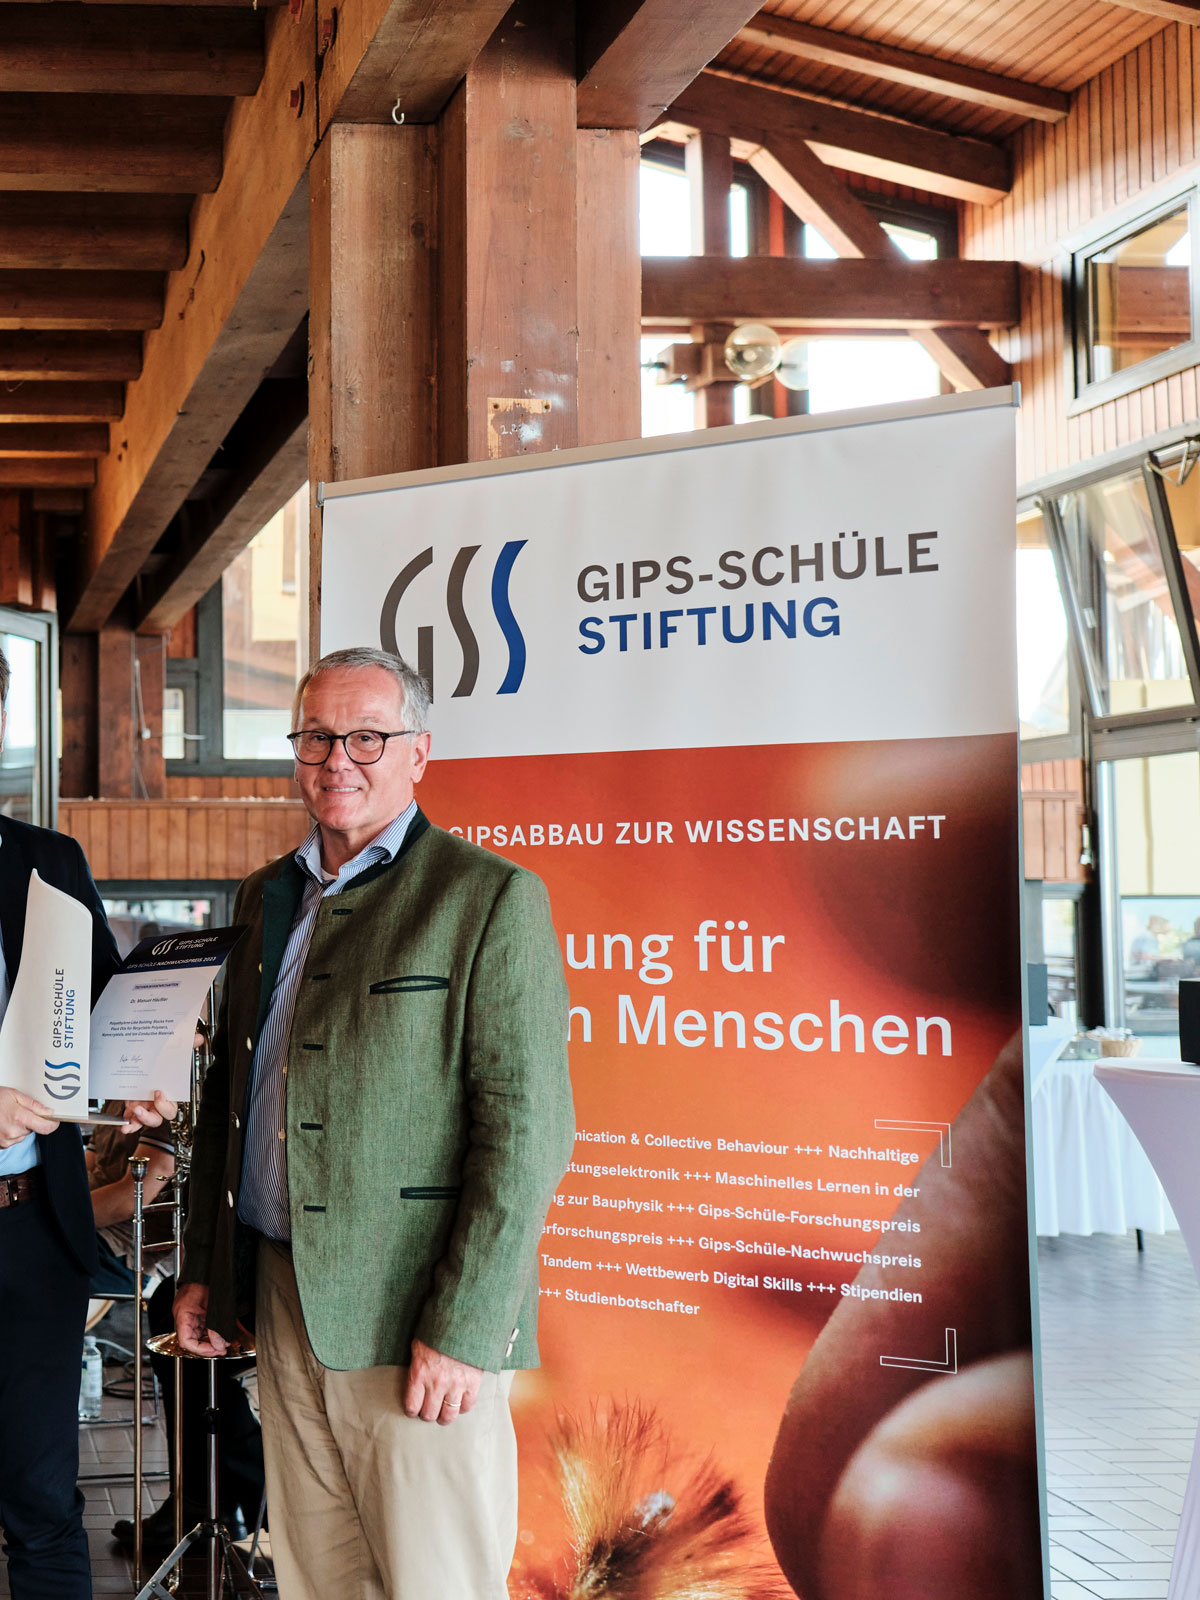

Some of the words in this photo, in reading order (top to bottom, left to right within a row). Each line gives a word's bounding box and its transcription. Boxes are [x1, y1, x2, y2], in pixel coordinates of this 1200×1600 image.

[577, 530, 940, 603] GIPS-SCHÜLE
[578, 596, 841, 655] STIFTUNG
[615, 821, 674, 845] ZUR
[685, 815, 946, 843] WISSENSCHAFT
[566, 933, 674, 985] ung
[693, 919, 786, 973] für
[52, 968, 65, 1048] GIPS-SCHÜLE
[64, 989, 76, 1049] STIFTUNG
[618, 993, 953, 1057] Menschen
[644, 1133, 712, 1150] Collective
[717, 1138, 789, 1155] Behaviour
[828, 1144, 920, 1166] Nachhaltige
[715, 1171, 813, 1191] Maschinelles
[817, 1178, 871, 1195] Lernen
[875, 1182, 890, 1196] in
[893, 1183, 921, 1198] der
[568, 1195, 589, 1206] zur
[592, 1194, 663, 1214] Bauphysik
[698, 1203, 921, 1234] Gips-Schüle-Forschungspreis
[698, 1236, 922, 1269] Gips-Schüle-Nachwuchspreis
[541, 1253, 592, 1271] Tandem
[625, 1262, 709, 1283] Wettbewerb
[713, 1271, 759, 1289] Digital
[762, 1276, 803, 1292] Skills
[840, 1283, 922, 1304] Stipendien
[565, 1288, 700, 1315] Studienbotschafter
